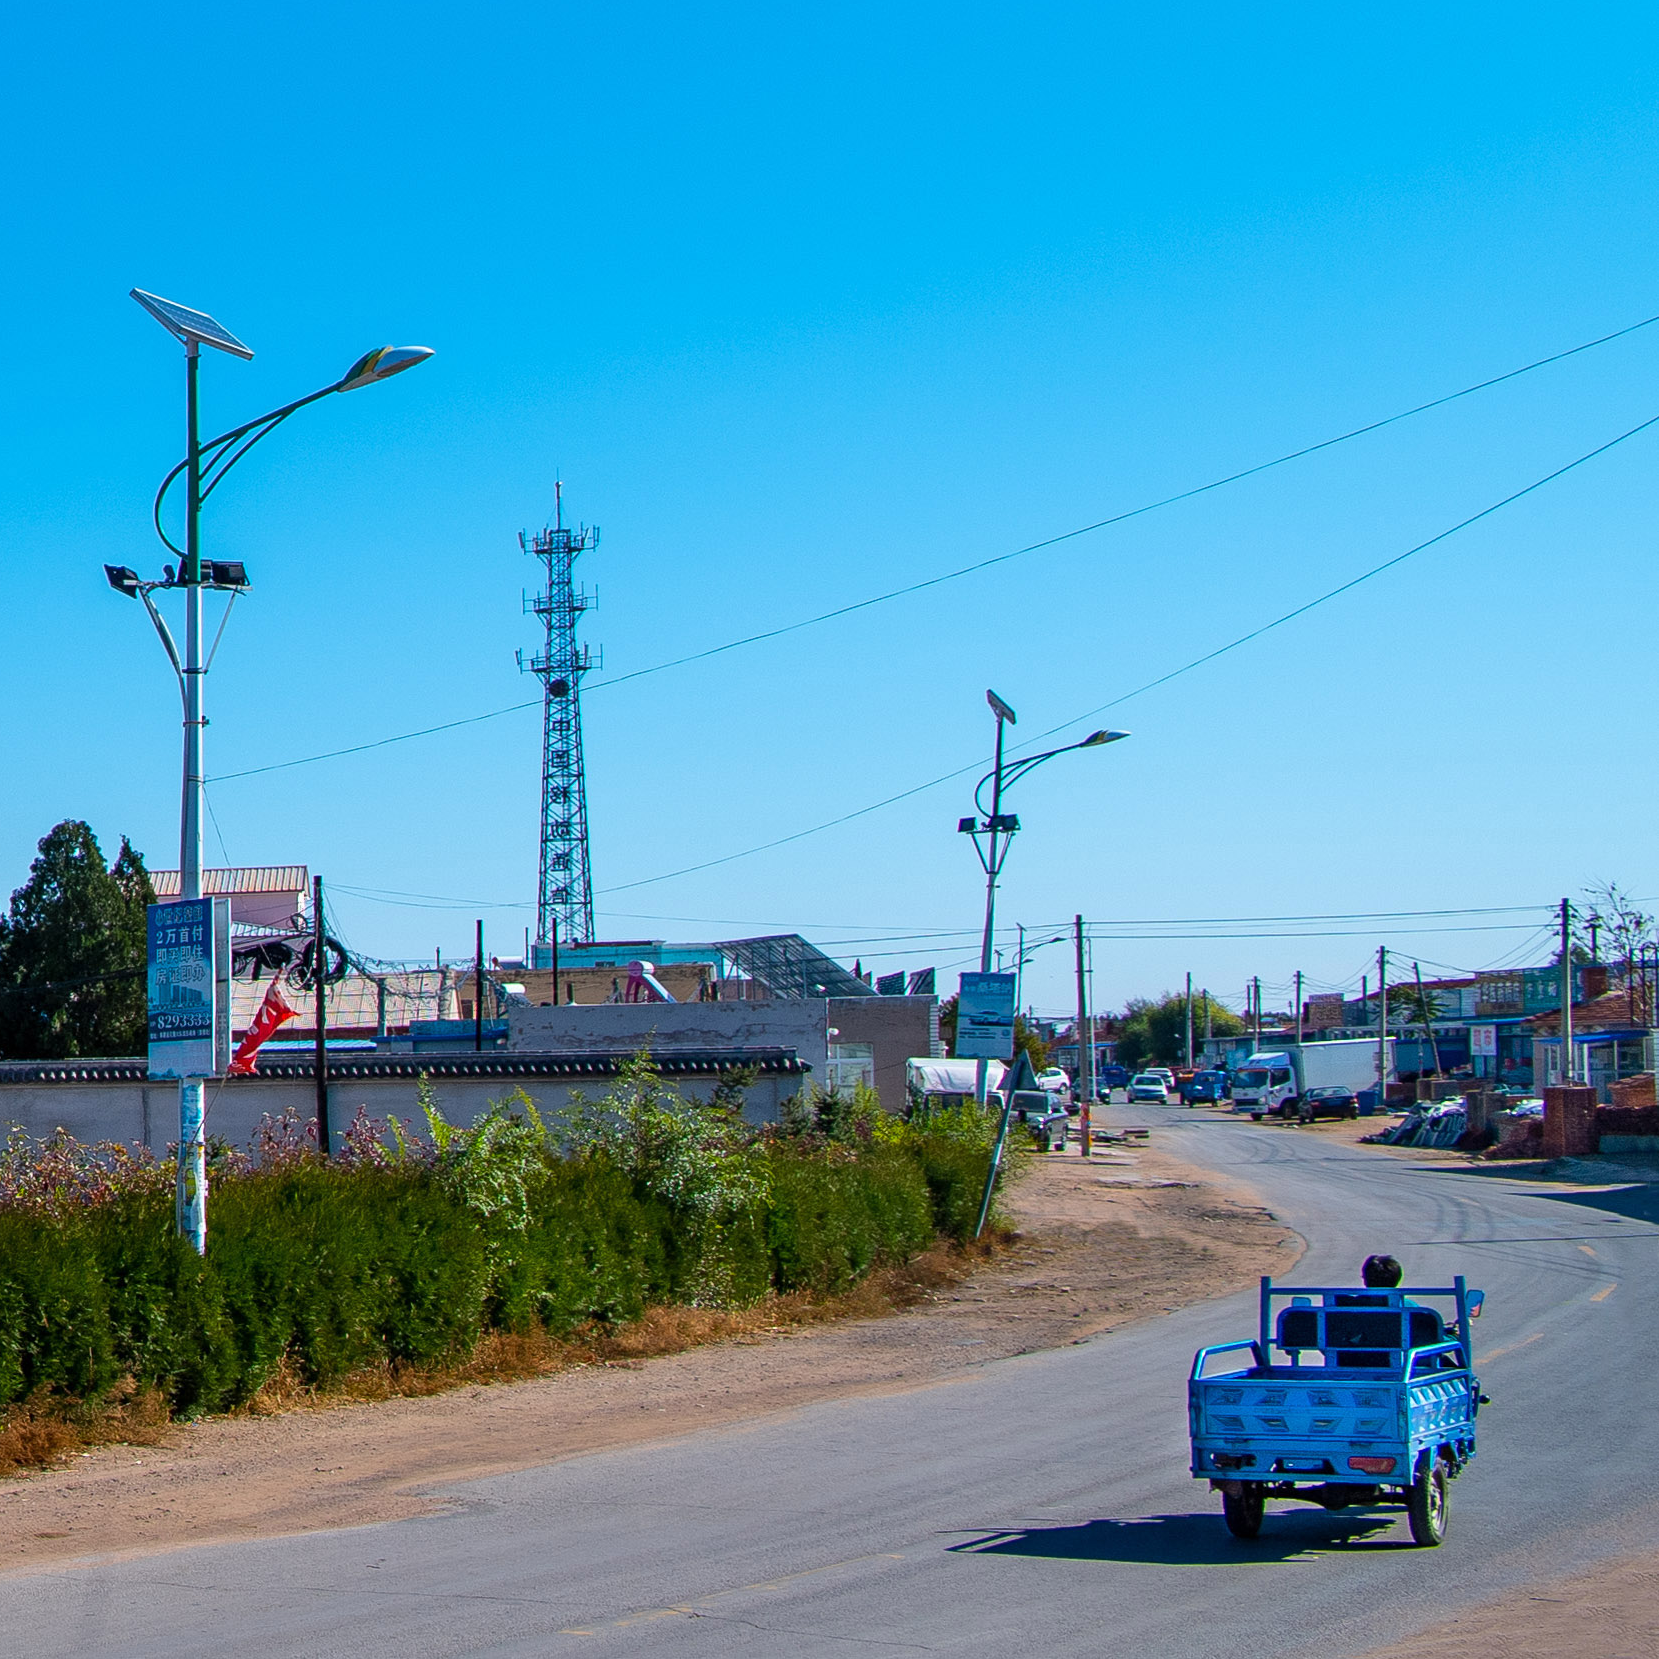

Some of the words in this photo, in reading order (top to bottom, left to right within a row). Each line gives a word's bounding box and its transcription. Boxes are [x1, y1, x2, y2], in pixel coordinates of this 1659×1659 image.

[156, 924, 204, 945] 2万首付
[156, 944, 204, 964] 即买即住
[155, 964, 205, 985] 房证即办
[157, 1012, 210, 1029] 8293333
